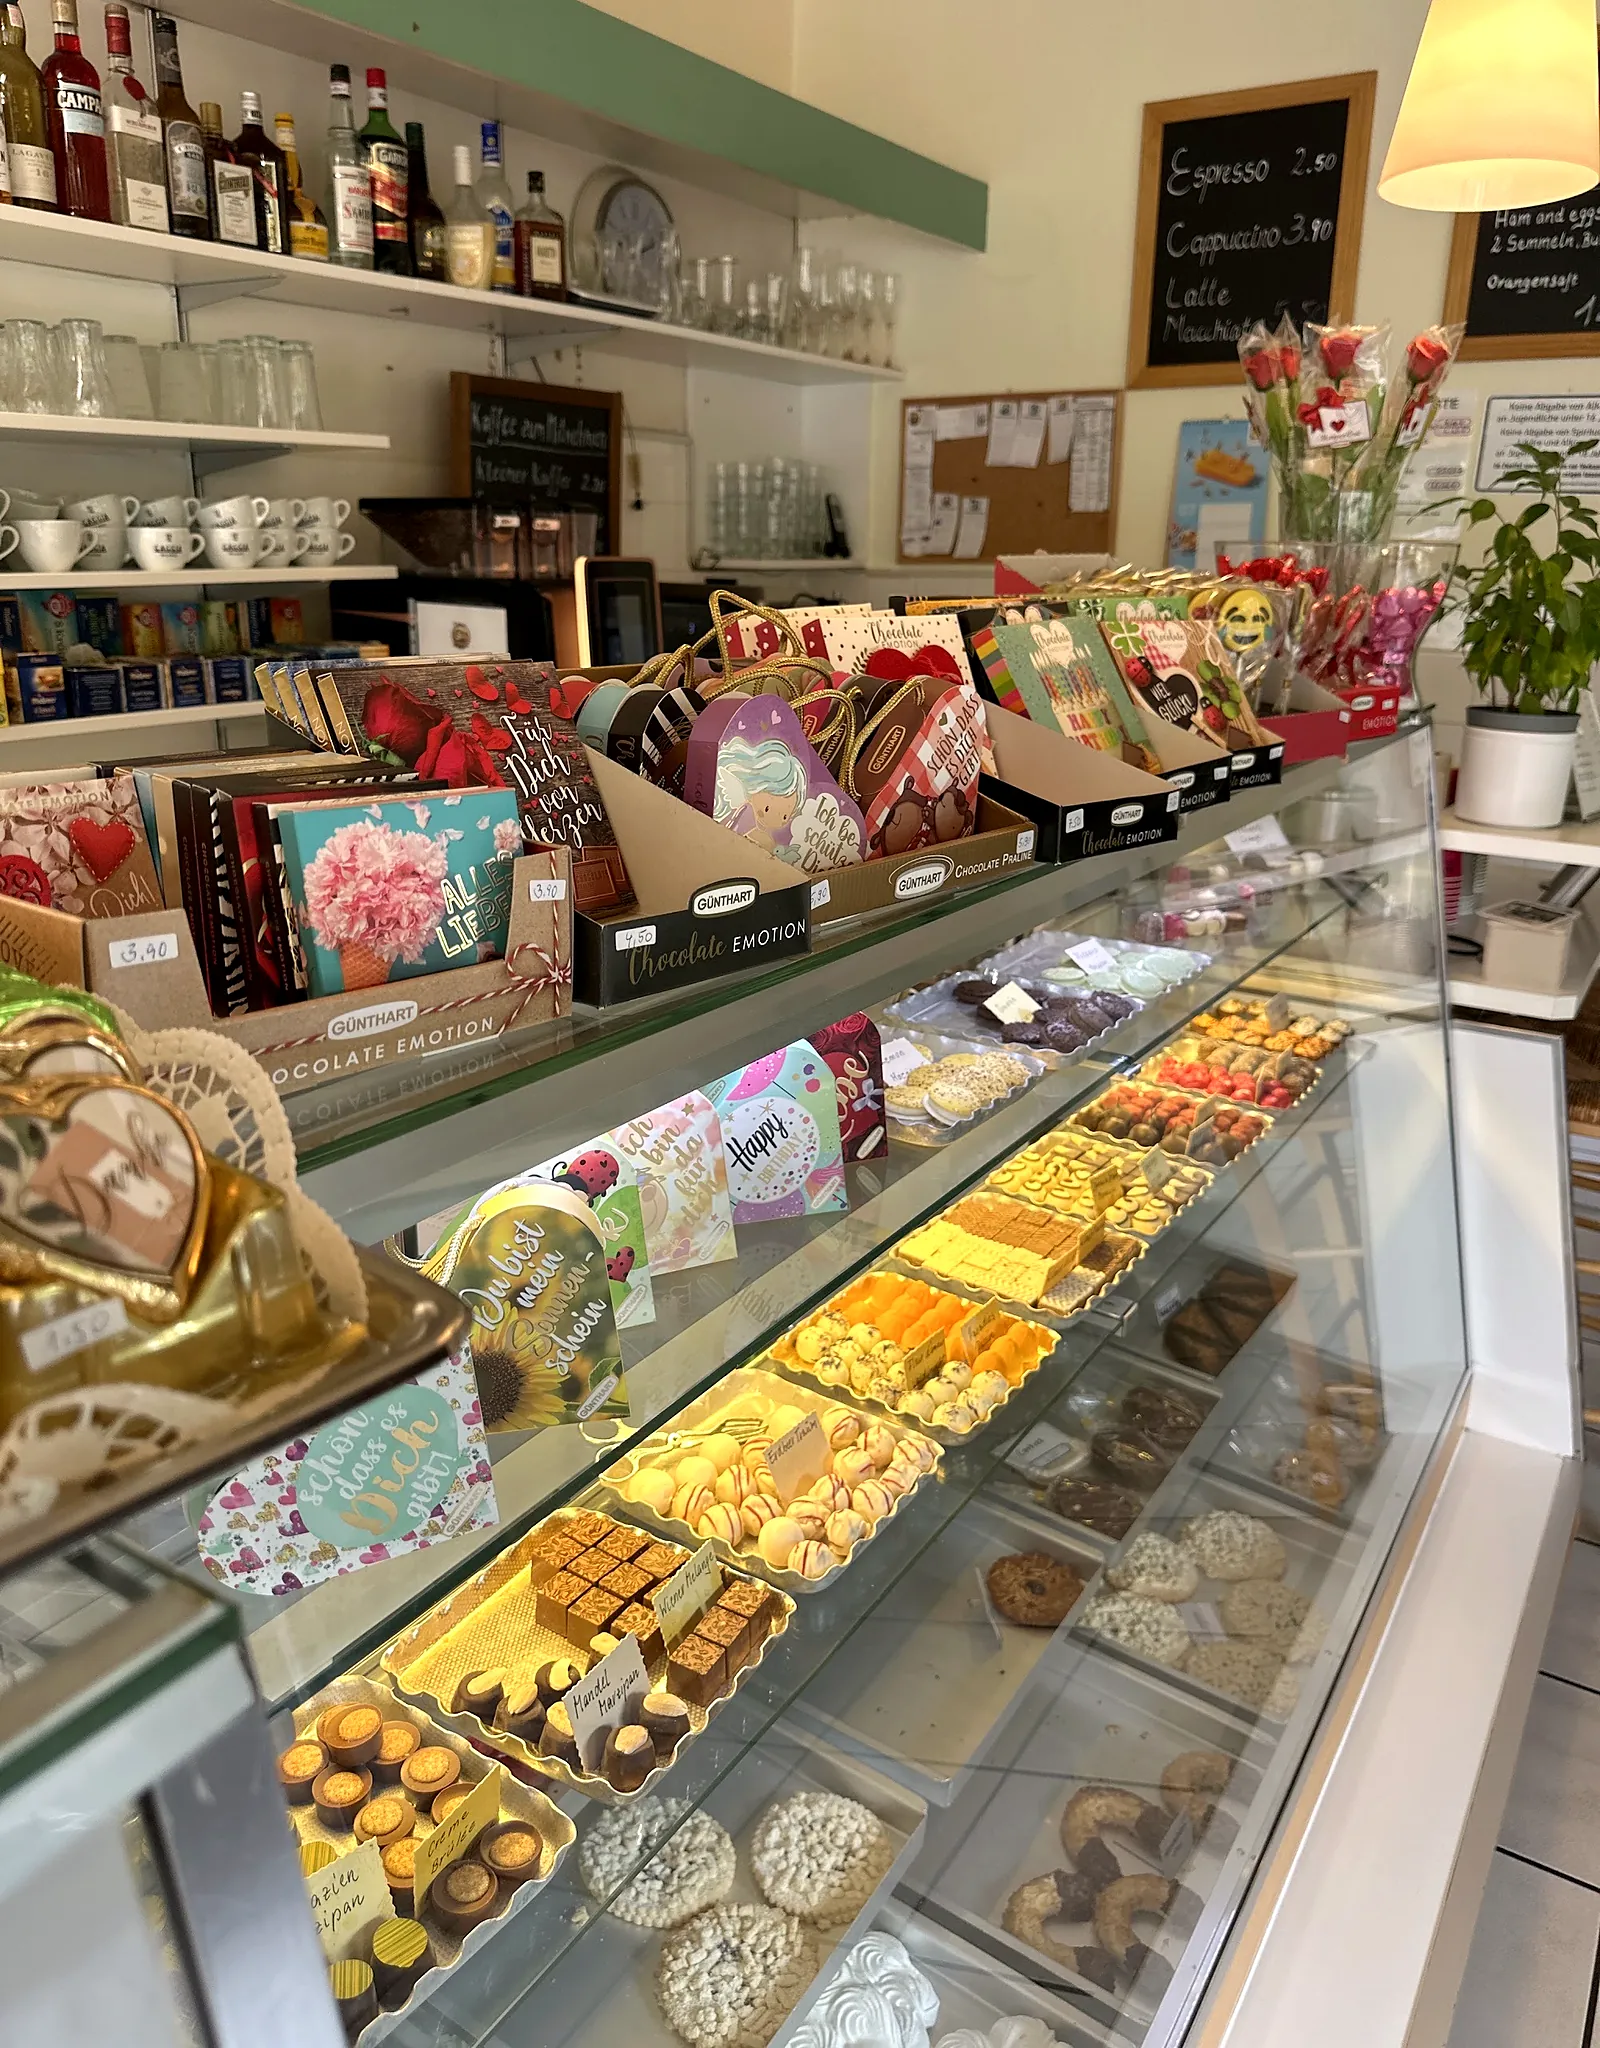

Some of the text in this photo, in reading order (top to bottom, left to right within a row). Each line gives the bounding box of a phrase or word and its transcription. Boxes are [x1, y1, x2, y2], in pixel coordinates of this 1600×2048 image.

[1166, 147, 1270, 205] Espresso
[1535, 207, 1565, 226] and
[1166, 221, 1282, 267] Cappuccino
[1490, 235, 1503, 254] 2
[1166, 276, 1232, 309] Latte
[1486, 272, 1579, 294] Orangensaft
[1163, 314, 1253, 343] Macchiat
[867, 620, 923, 644] Chocolate
[881, 640, 919, 648] EMOTION
[1150, 681, 1172, 702] VIEL
[1159, 693, 1196, 724] GLÜCK!
[955, 694, 980, 733] DASS
[500, 711, 552, 759] Für
[873, 728, 902, 770] GÜNTHART
[946, 728, 977, 780] ES DICH
[504, 738, 573, 799] Dich
[957, 750, 981, 788] GIBT
[1240, 773, 1272, 786] EMOTION
[538, 784, 580, 815] von
[814, 795, 838, 831] Ich
[1113, 807, 1142, 822] GÜNTHART
[1180, 790, 1216, 807] EMOTION
[1081, 828, 1163, 855] Chocolate EMOTION
[899, 870, 942, 893] GÜNTHART
[955, 850, 1032, 879] CHOCOLATE PRALINE
[90, 871, 160, 919] Dich!
[697, 889, 753, 911] GÜNTHART
[625, 918, 806, 986] Chocolate EMOTION
[331, 1005, 415, 1036] GÜNTHART
[272, 1016, 495, 1085] OCOLATE EMOTION
[620, 1117, 654, 1156] ich
[640, 1124, 681, 1166] bin
[676, 1134, 704, 1170] da
[726, 1112, 790, 1173] Happy
[674, 1157, 708, 1197] für
[757, 1132, 803, 1185] BIRTHDAY
[458, 1218, 545, 1332] Du bist
[516, 1250, 565, 1310] mein
[545, 1298, 607, 1377] schein
[579, 1378, 616, 1418] GÜNTHART
[333, 1402, 408, 1499] dass es
[340, 1409, 439, 1536] Dich
[407, 1449, 458, 1518] gibt!
[446, 1485, 486, 1533] GÜNTHART
[572, 1668, 611, 1720] Mandel
[598, 1668, 641, 1717] Marzipan
[427, 1808, 470, 1859] Creme
[310, 1867, 360, 1910] azien
[314, 1893, 366, 1935] zipan
